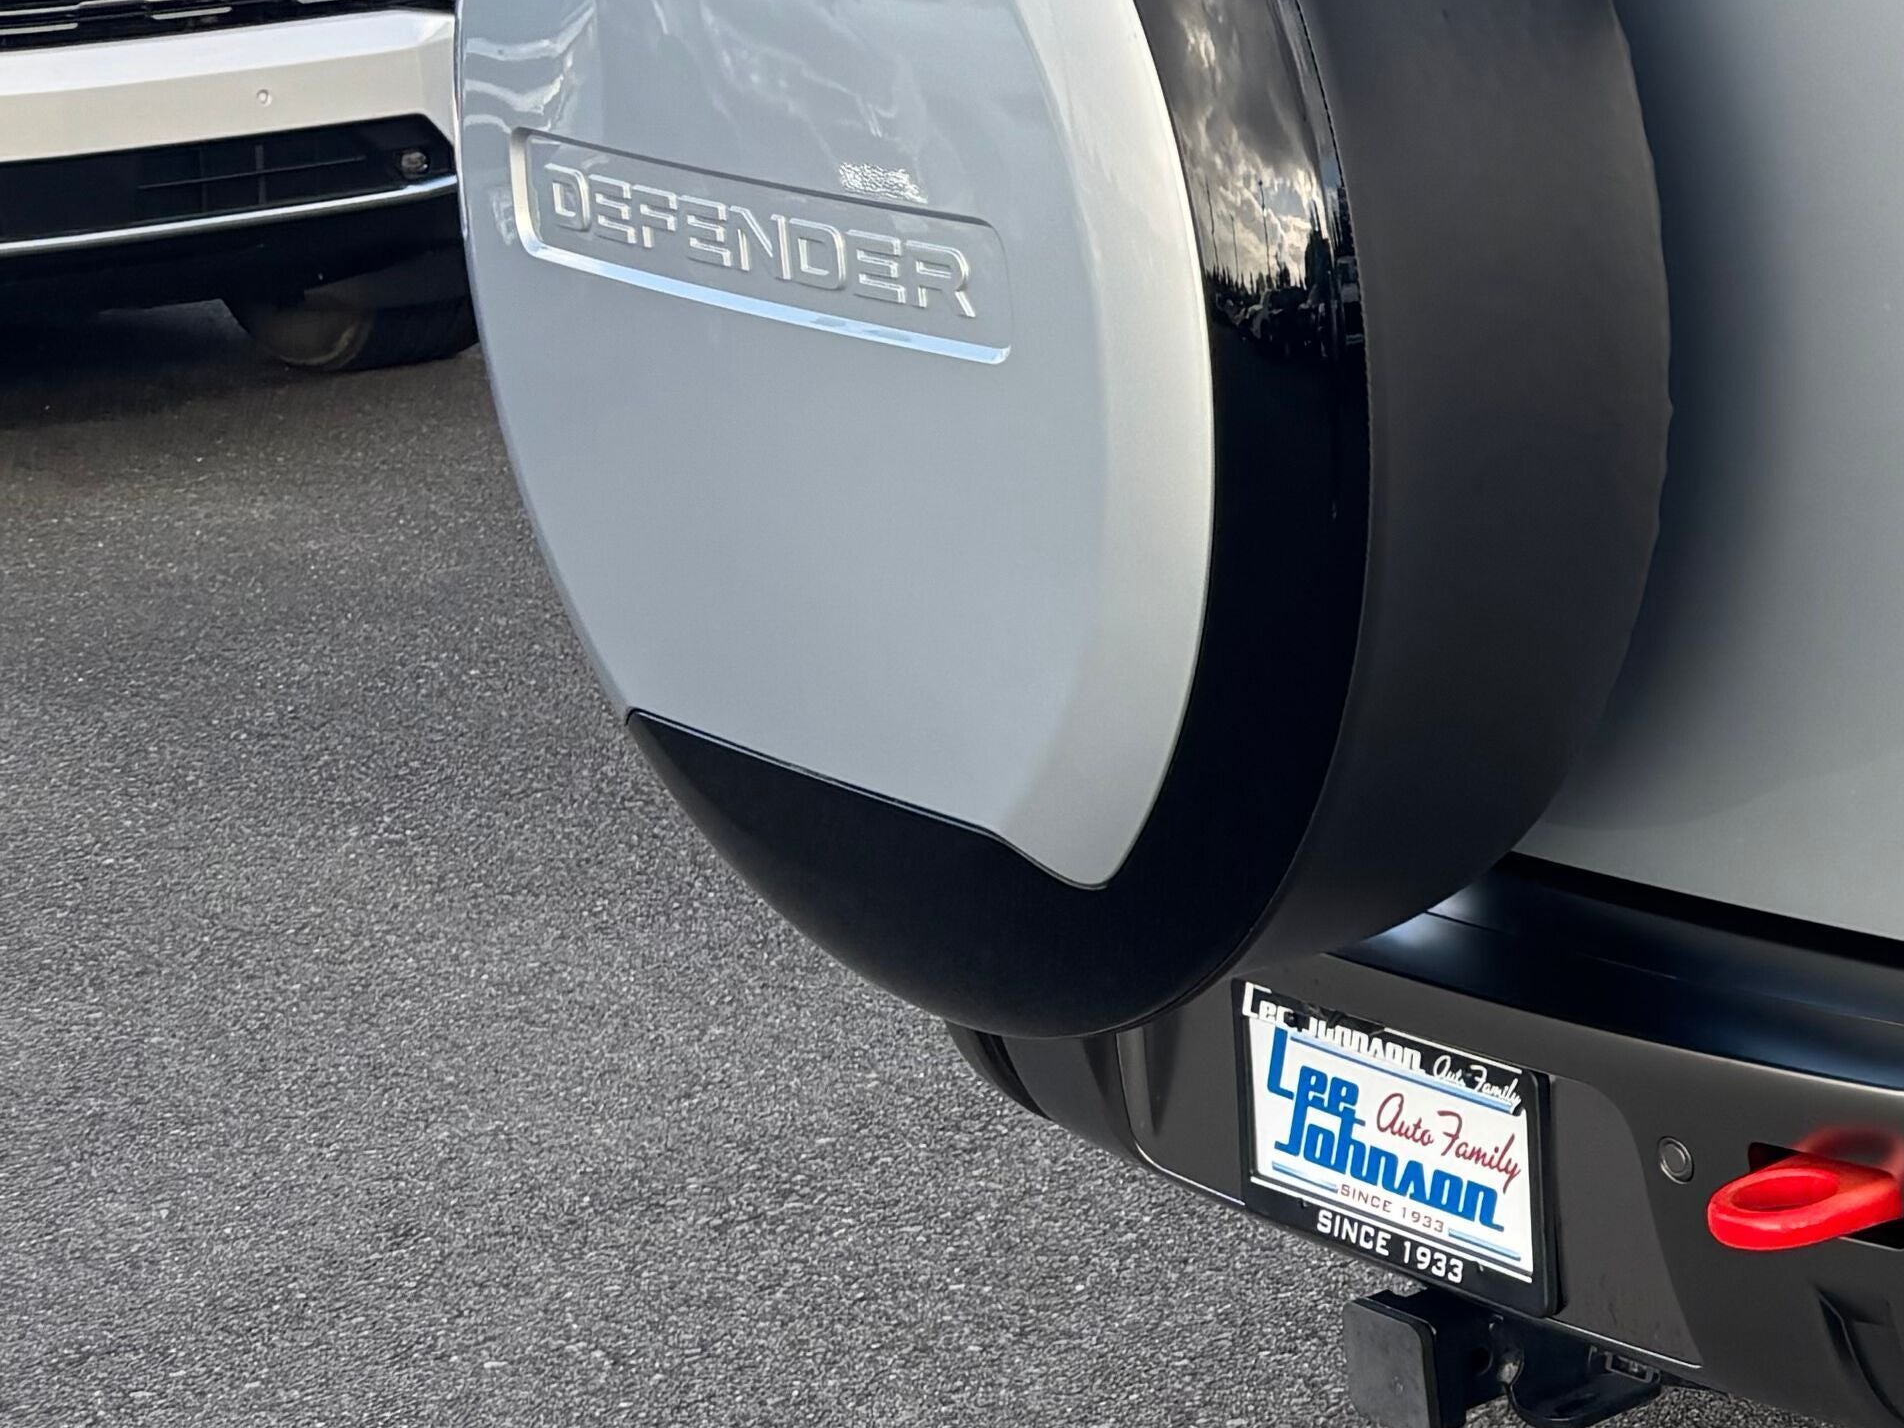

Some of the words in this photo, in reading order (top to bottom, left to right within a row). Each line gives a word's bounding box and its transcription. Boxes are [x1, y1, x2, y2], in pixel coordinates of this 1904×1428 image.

[543, 162, 977, 318] DEFENDER
[1267, 1028, 1360, 1114] Lee
[1433, 1055, 1468, 1087] Aut
[1473, 1065, 1524, 1115] Family
[1274, 1102, 1504, 1232] Johnson
[1376, 1092, 1434, 1146] Auto
[1438, 1110, 1522, 1194] Family
[1316, 1211, 1391, 1256] SINCE
[1403, 1240, 1465, 1284] 1933
[1338, 1184, 1392, 1213] SINCE
[1401, 1206, 1445, 1234] 1933
